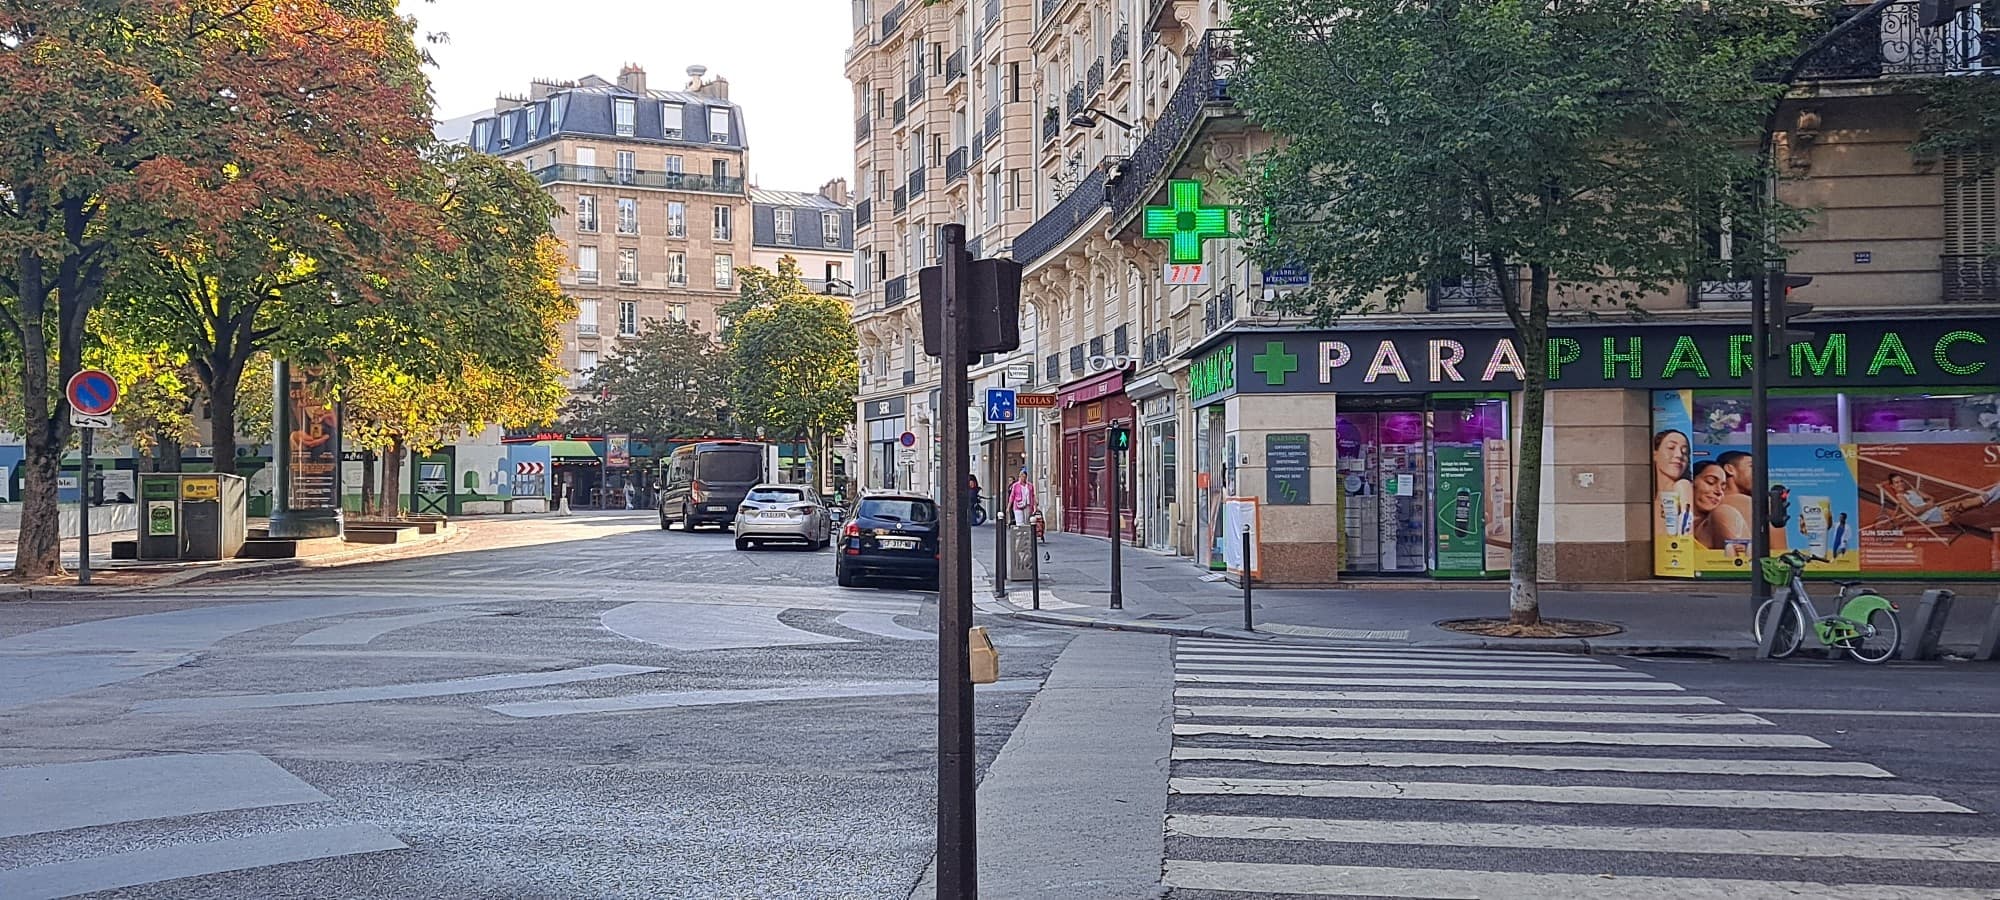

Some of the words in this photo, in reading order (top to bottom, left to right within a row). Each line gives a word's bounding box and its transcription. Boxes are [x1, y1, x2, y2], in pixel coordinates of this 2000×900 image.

[1170, 265, 1203, 283] 7/7
[1190, 344, 1234, 402] PHARMACIE
[1279, 480, 1298, 503] 7/7
[1861, 529, 1876, 537] SUN
